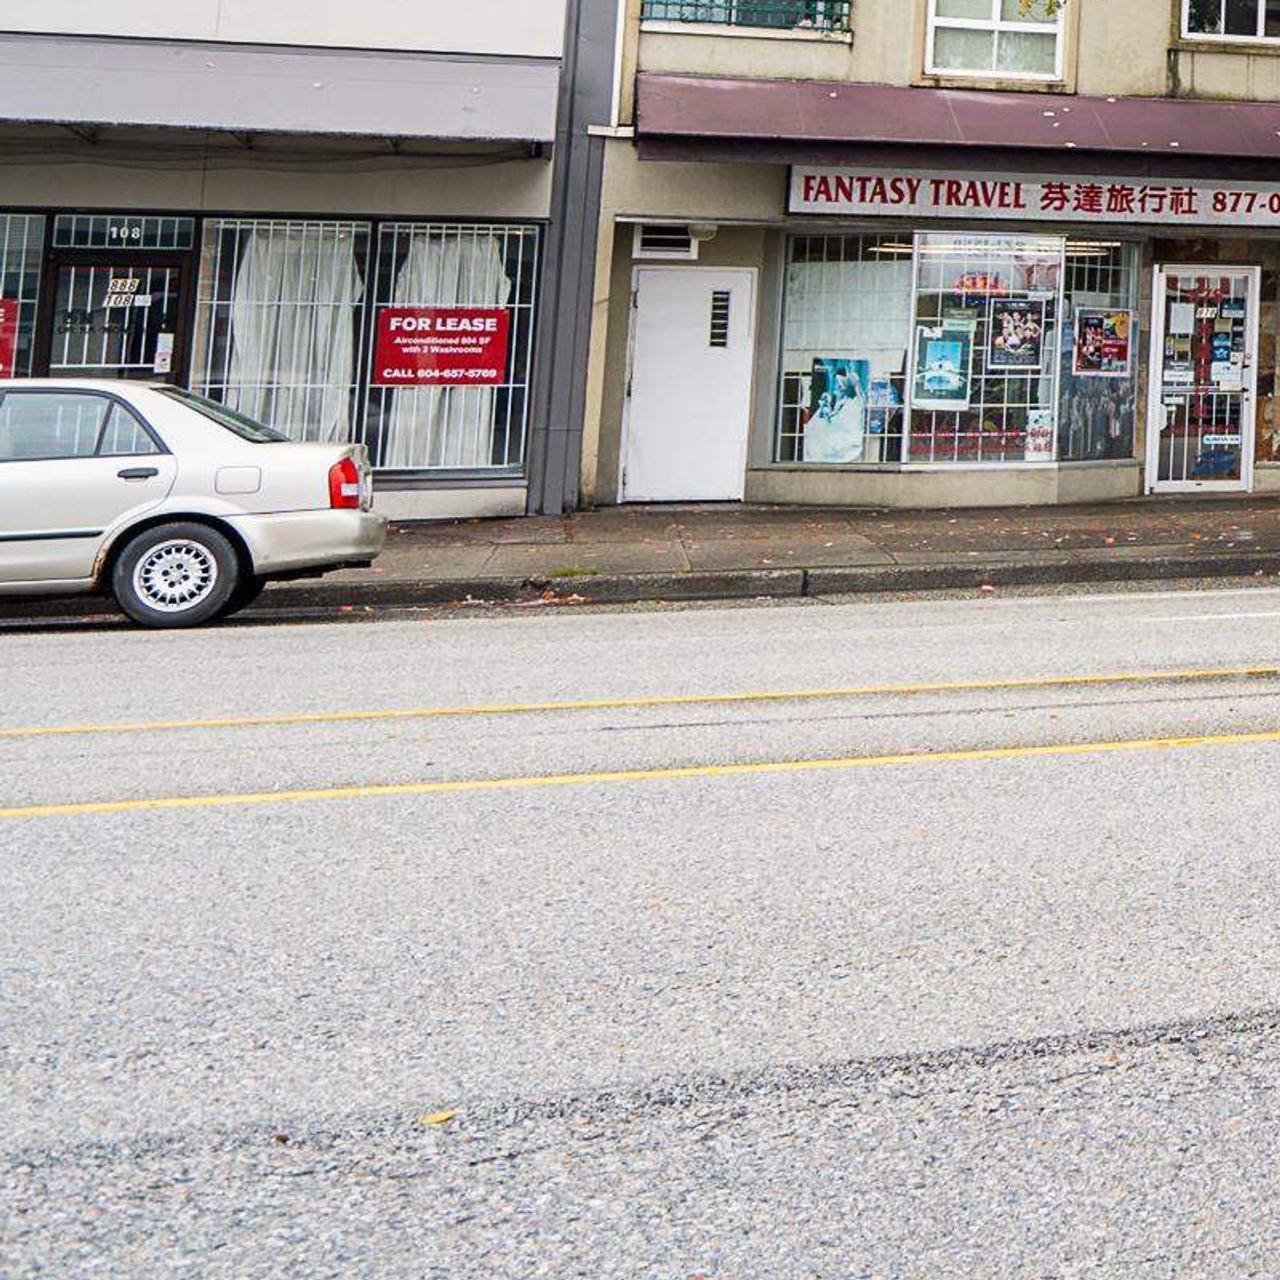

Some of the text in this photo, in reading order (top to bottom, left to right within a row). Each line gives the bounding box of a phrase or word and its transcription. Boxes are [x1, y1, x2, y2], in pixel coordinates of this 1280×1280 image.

[803, 175, 922, 205] FANTASY
[930, 179, 1027, 209] TRAVEL
[1040, 182, 1198, 215] 芬達旅行社
[110, 227, 141, 239] 108
[390, 317, 498, 332] FOR LEASE
[382, 368, 415, 378] CALL
